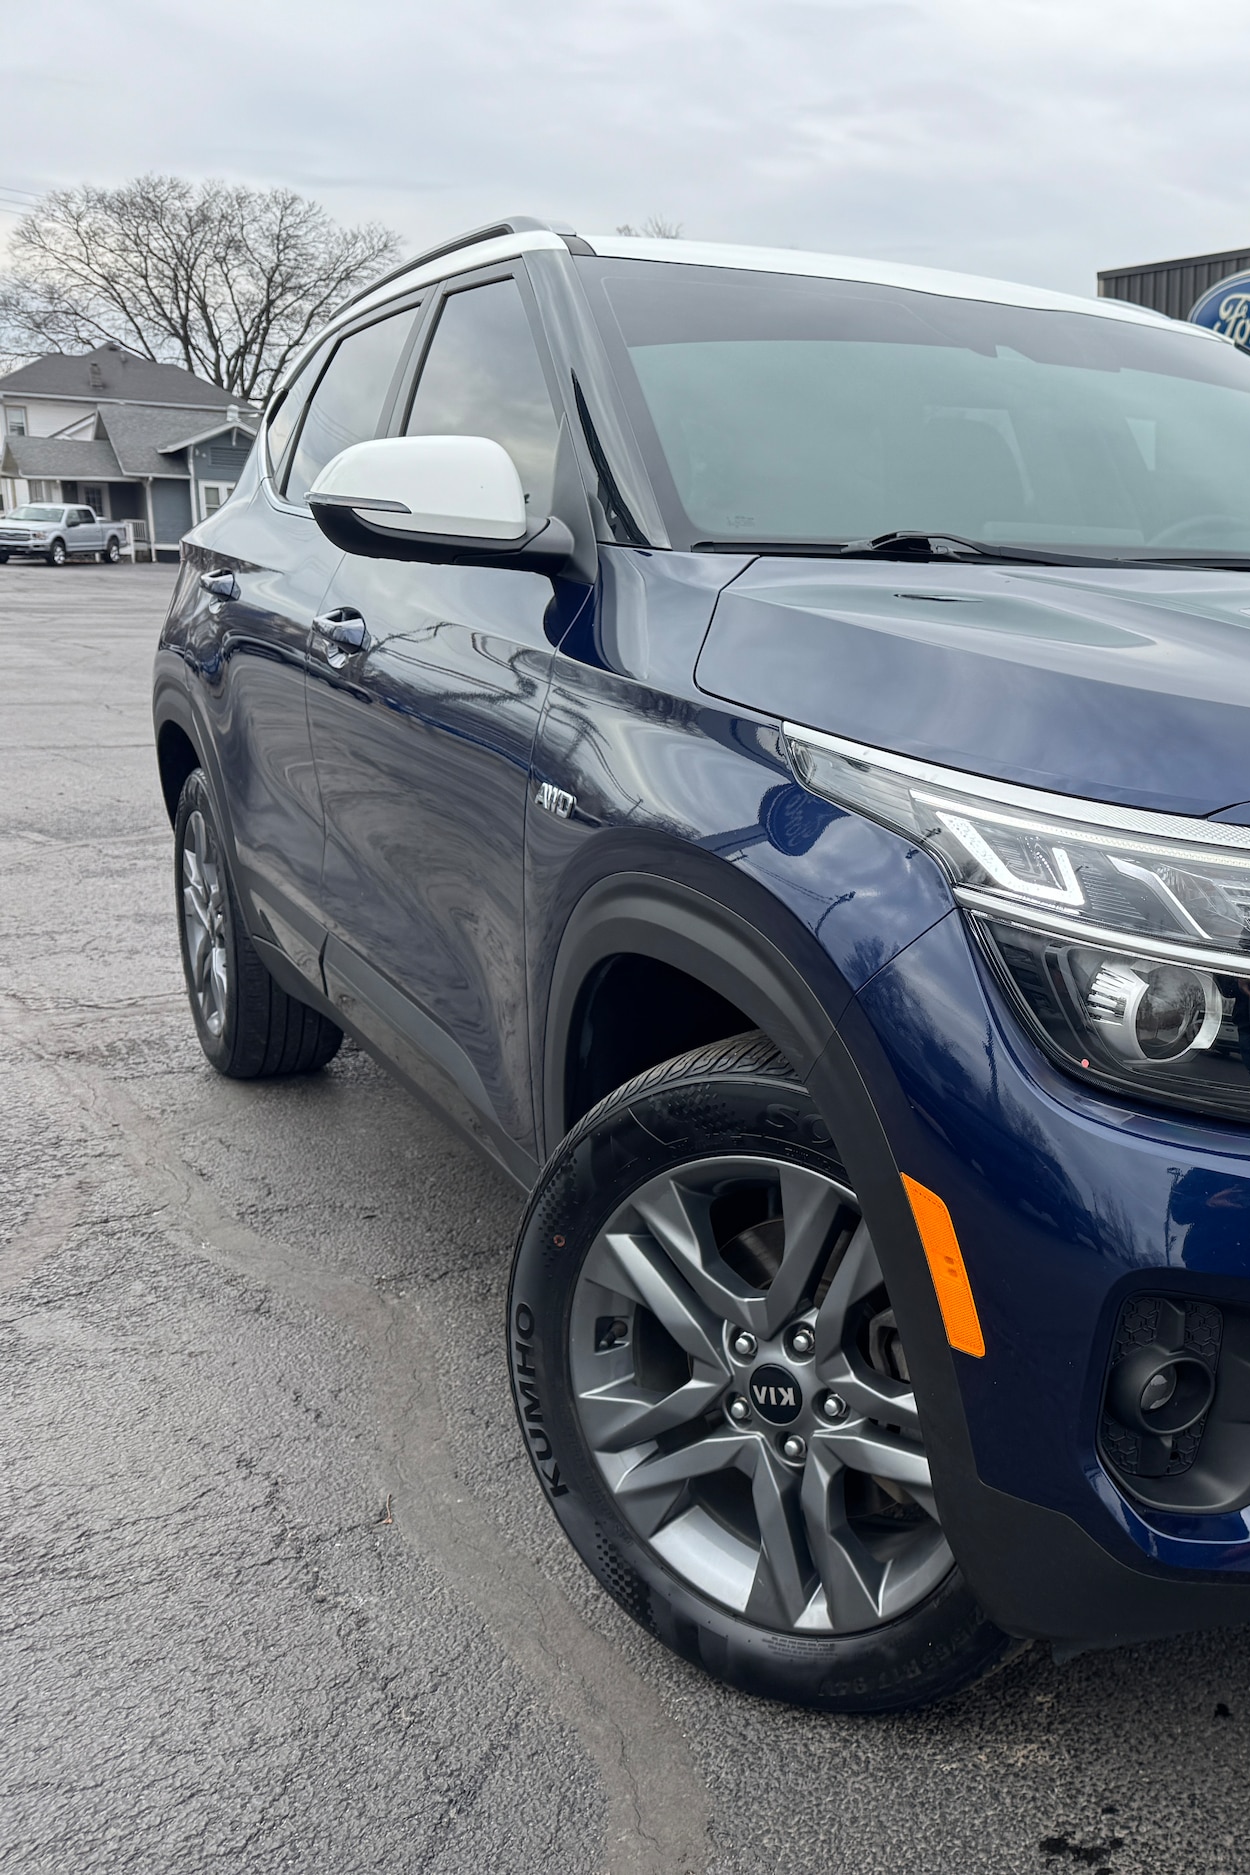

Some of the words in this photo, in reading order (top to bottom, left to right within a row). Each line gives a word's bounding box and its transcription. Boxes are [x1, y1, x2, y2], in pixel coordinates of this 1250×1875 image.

[534, 782, 577, 819] AWD
[515, 1302, 570, 1498] KUMHO
[752, 1384, 796, 1406] KIA
